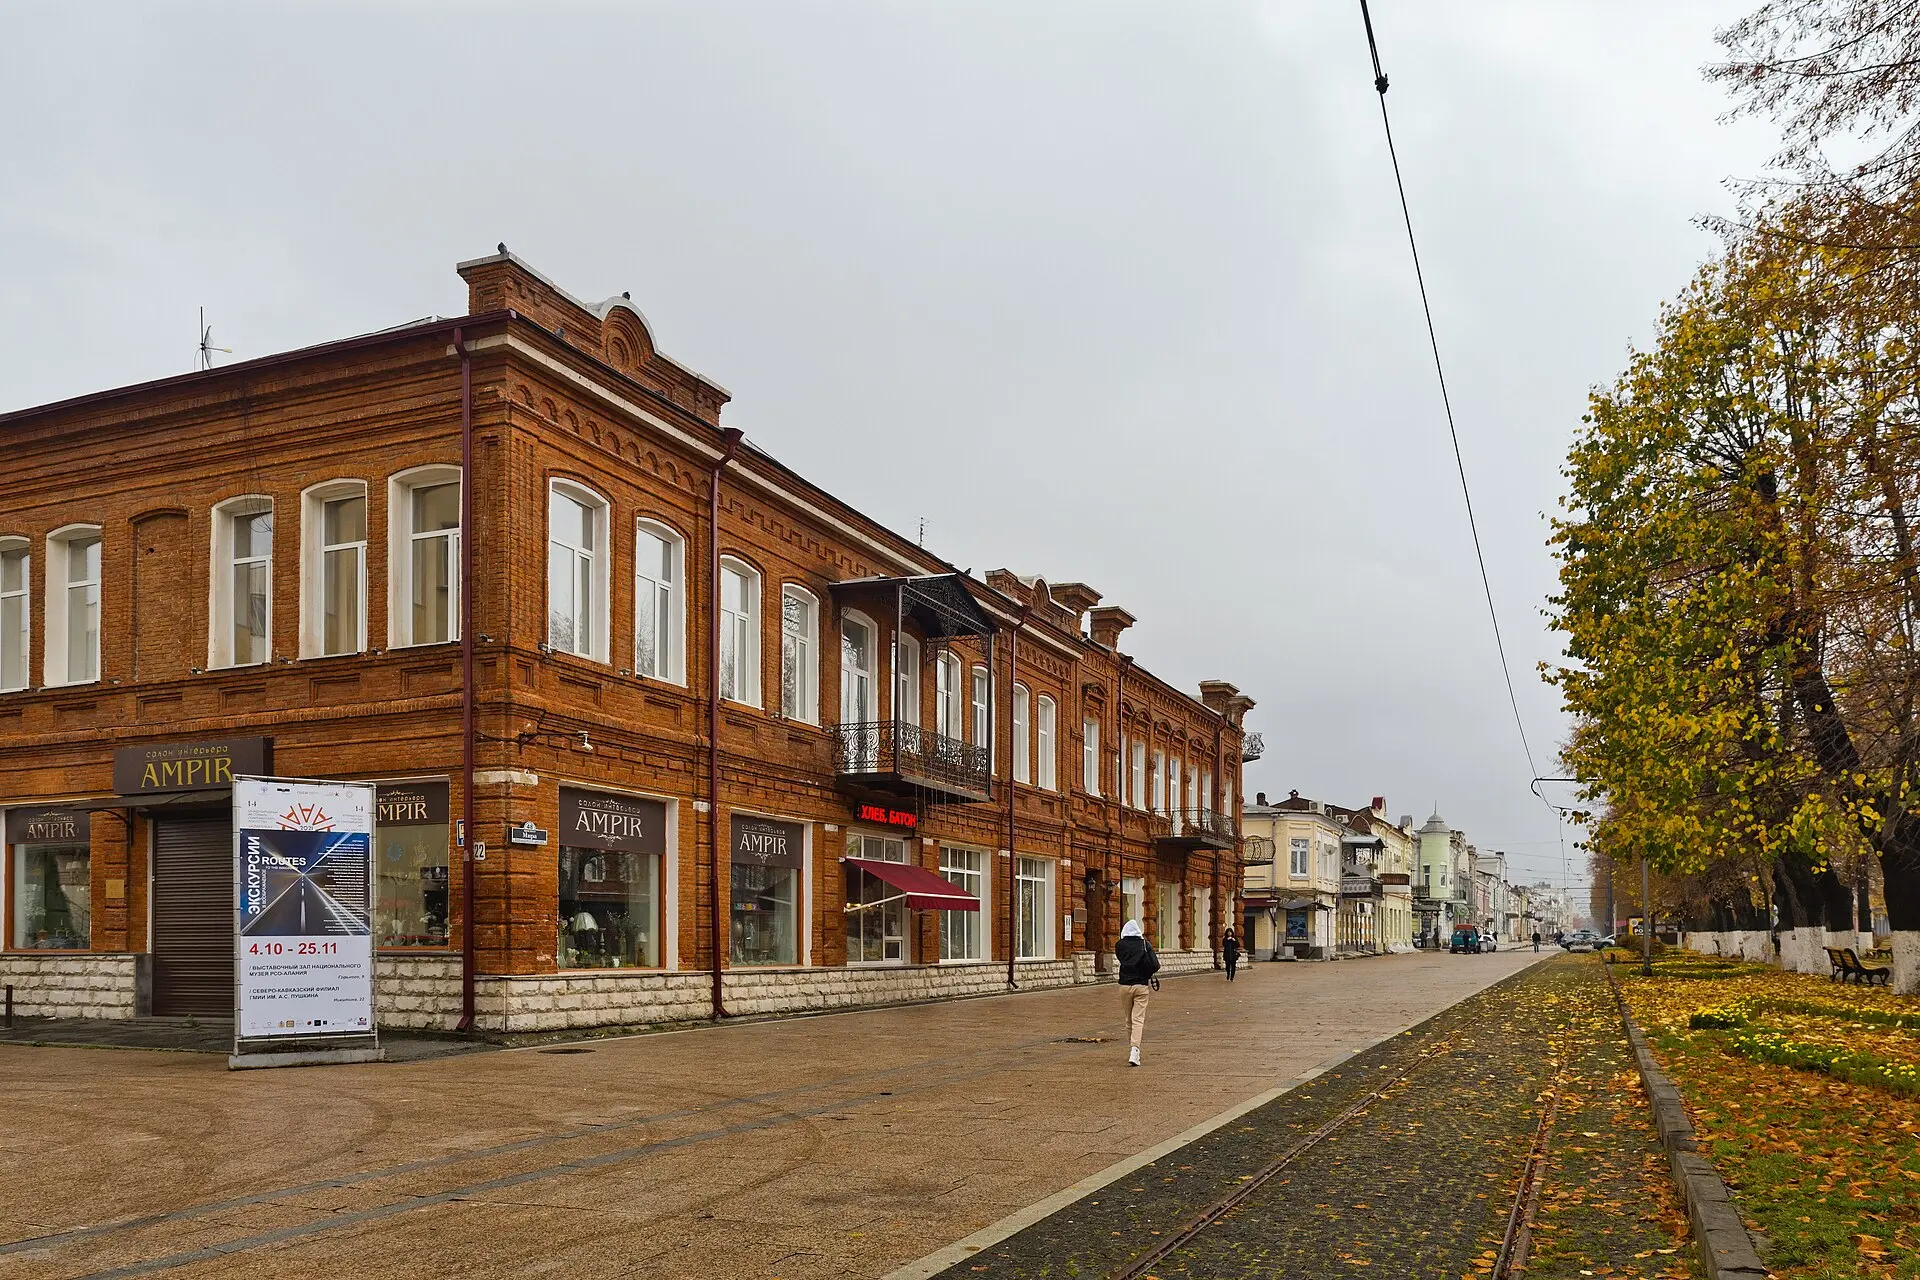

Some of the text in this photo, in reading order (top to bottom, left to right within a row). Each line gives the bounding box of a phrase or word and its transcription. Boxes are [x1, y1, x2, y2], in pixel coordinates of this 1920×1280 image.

[140, 757, 233, 788] AMPIR
[376, 802, 429, 821] MPIR
[861, 804, 917, 828] ХЛЕБ, БАТОН
[26, 822, 76, 839] AMPIR
[575, 810, 643, 838] AMPIR
[474, 844, 485, 858] 22
[739, 833, 787, 855] AMPIR
[261, 856, 307, 867] ROUTES
[247, 836, 261, 915] ЭКСКУРСИИ
[249, 942, 283, 955] 4.10
[298, 942, 337, 955] 25.11
